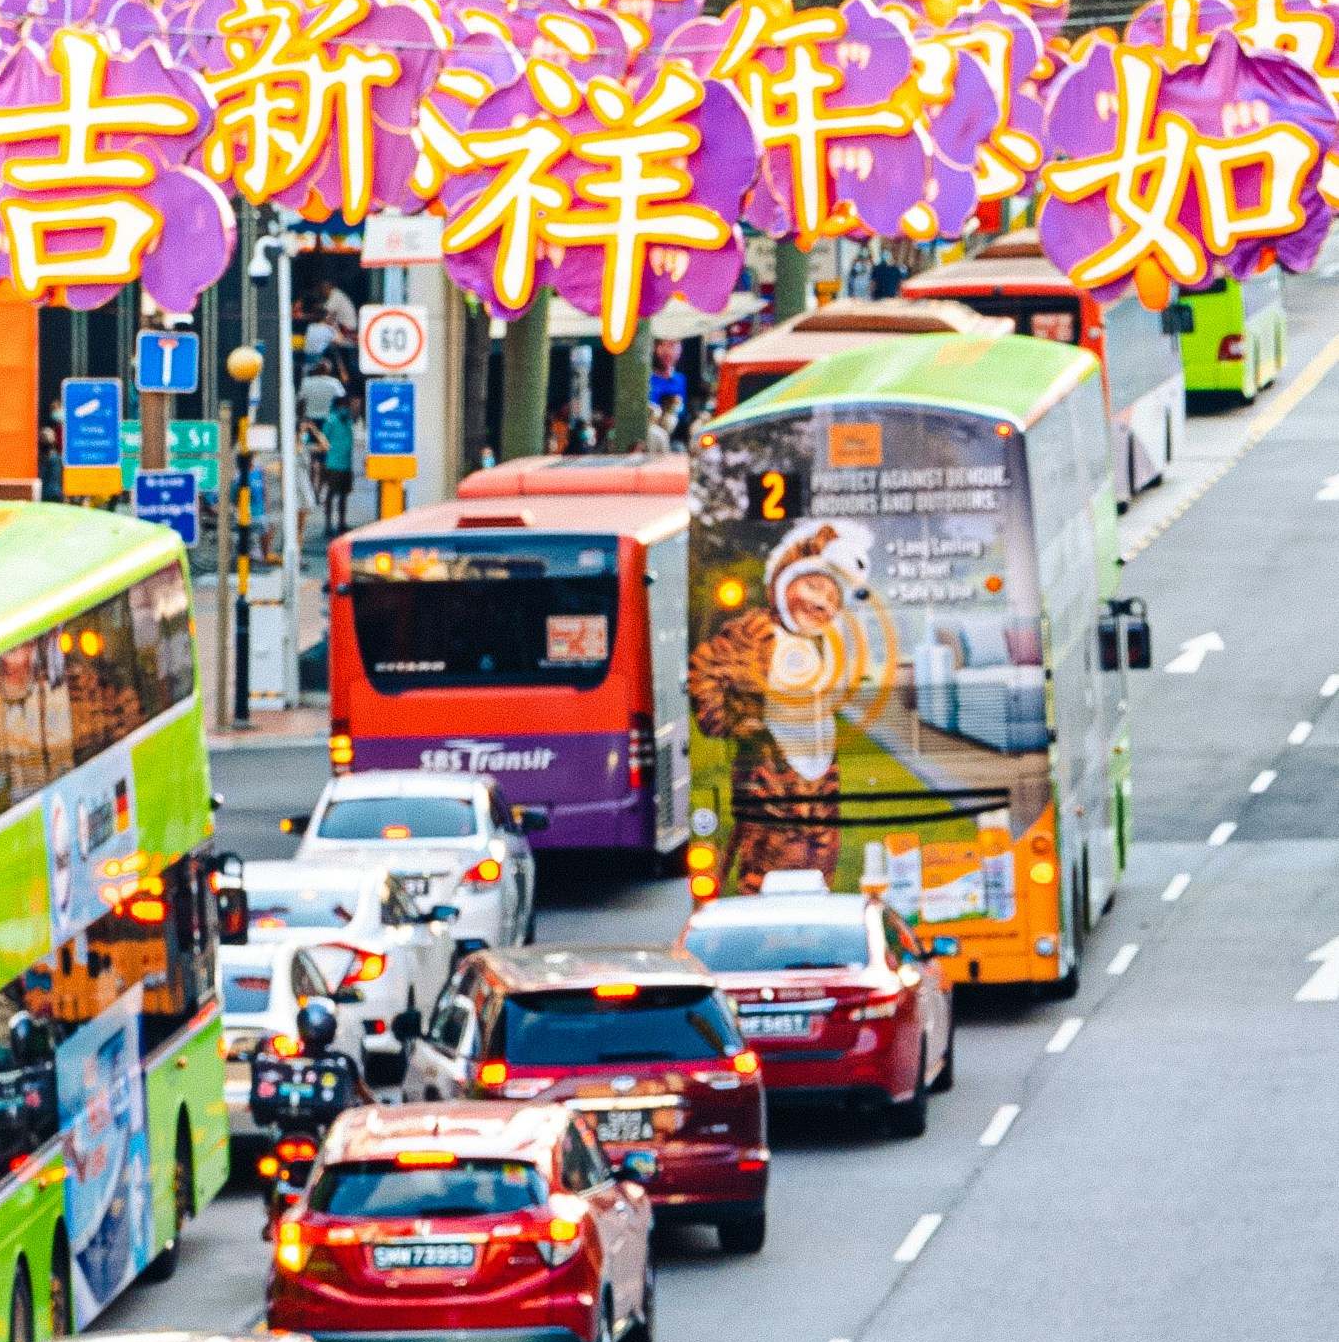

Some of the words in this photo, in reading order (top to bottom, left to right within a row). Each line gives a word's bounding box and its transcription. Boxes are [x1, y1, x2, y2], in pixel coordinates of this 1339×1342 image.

[442, 56, 730, 354] 祥
[1043, 43, 1320, 285] 如
[762, 471, 786, 520] 2
[880, 492, 913, 513] AND
[419, 749, 463, 773] SBS
[467, 740, 557, 772] Transit
